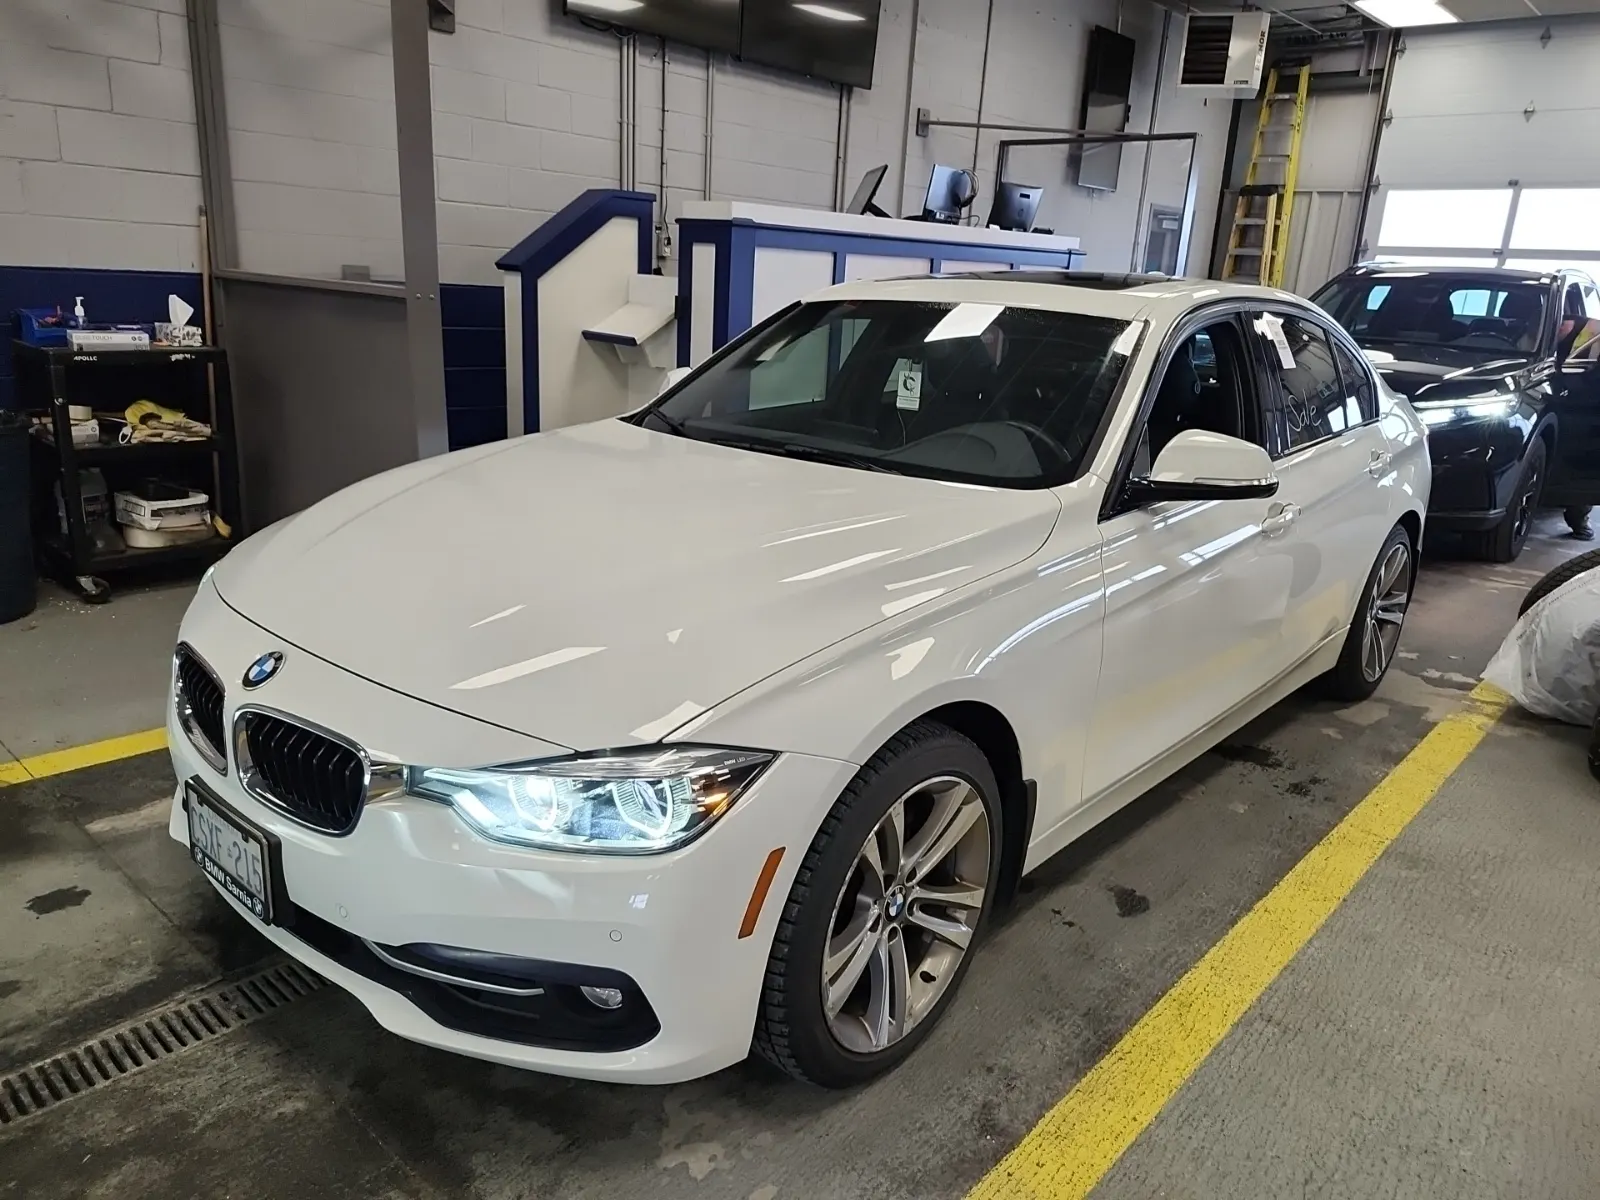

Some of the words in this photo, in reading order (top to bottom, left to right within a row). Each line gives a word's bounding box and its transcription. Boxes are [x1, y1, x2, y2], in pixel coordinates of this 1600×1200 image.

[1288, 388, 1322, 432] Sale
[191, 806, 222, 859] CSXF
[233, 841, 262, 893] 215
[205, 857, 225, 884] BMW
[226, 876, 252, 908] Sarnia
